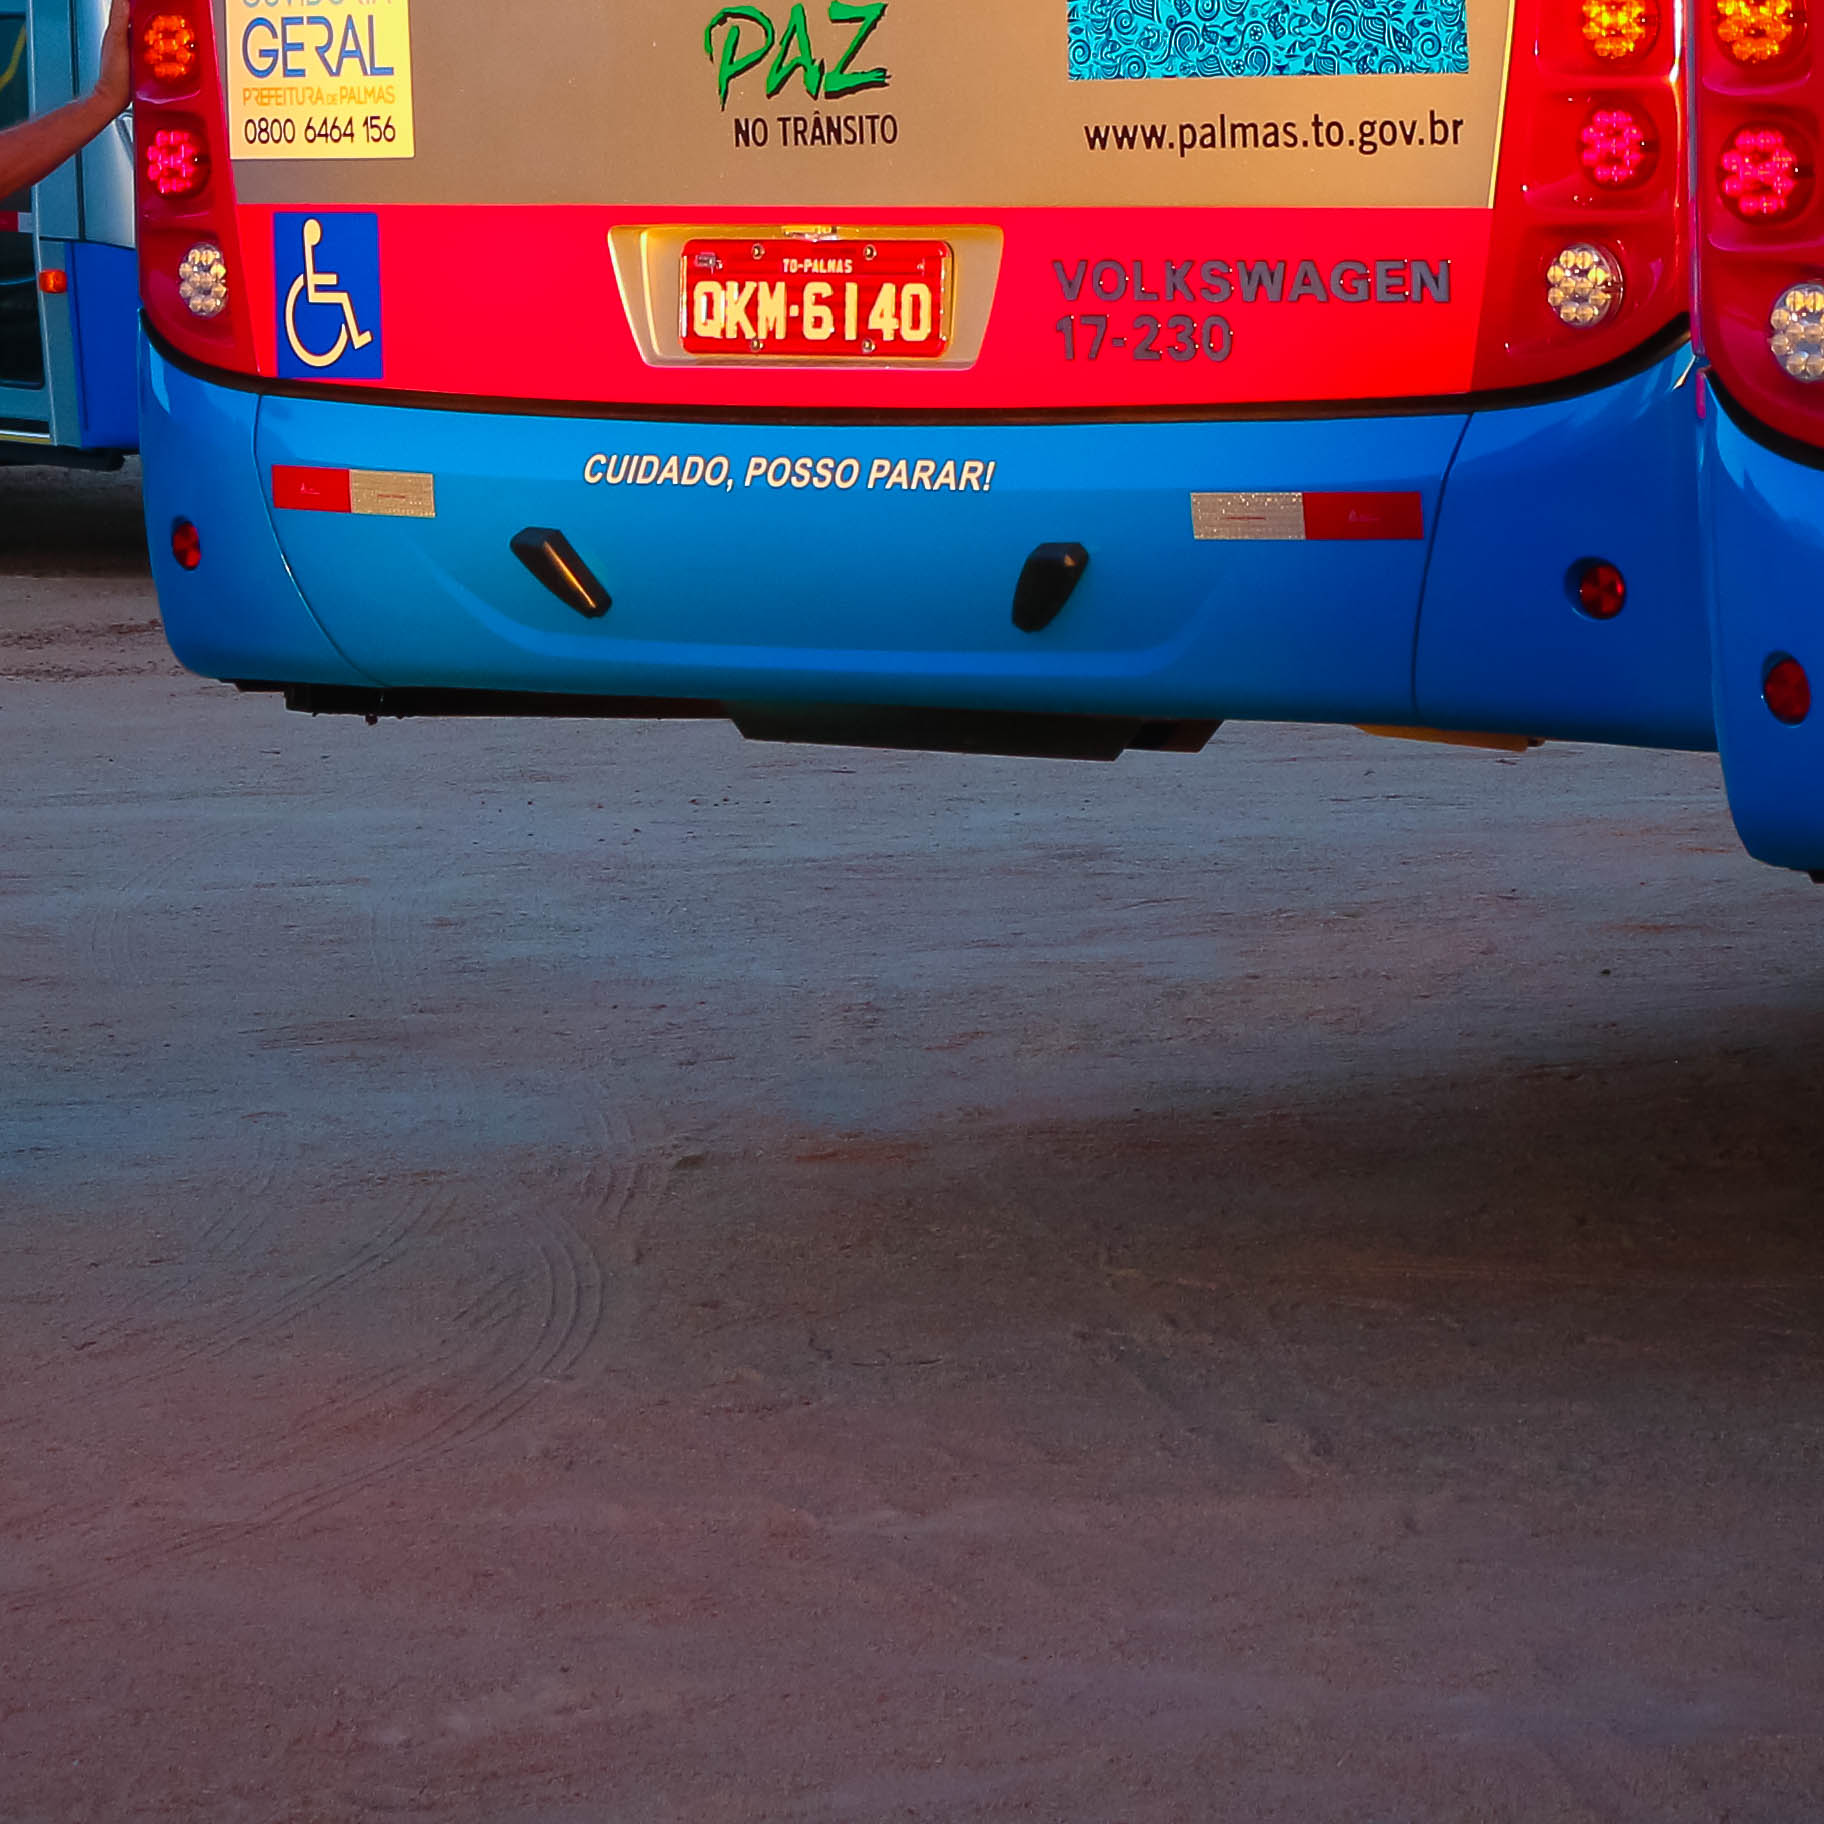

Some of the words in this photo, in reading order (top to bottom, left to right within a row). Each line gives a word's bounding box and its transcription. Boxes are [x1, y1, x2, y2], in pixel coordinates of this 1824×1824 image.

[242, 14, 394, 79] GERAL
[704, 0, 892, 112] PAZ
[243, 86, 325, 106] PREFEITURA
[339, 85, 396, 105] PALMAS
[244, 117, 296, 144] 0800
[304, 115, 355, 144] 6464
[362, 115, 396, 144] 156
[734, 117, 768, 147] NO
[776, 110, 898, 147] TRÂNSITO
[1083, 108, 1465, 159] www.palmas.to.gov.br
[782, 258, 853, 274] TO-PALMAS
[1051, 259, 1453, 303] VOLKSWAGEN
[1054, 313, 1235, 363] 17-230
[582, 452, 734, 493] CUIDADO,
[744, 456, 860, 490] POSSO
[867, 459, 997, 492] PARAR!
